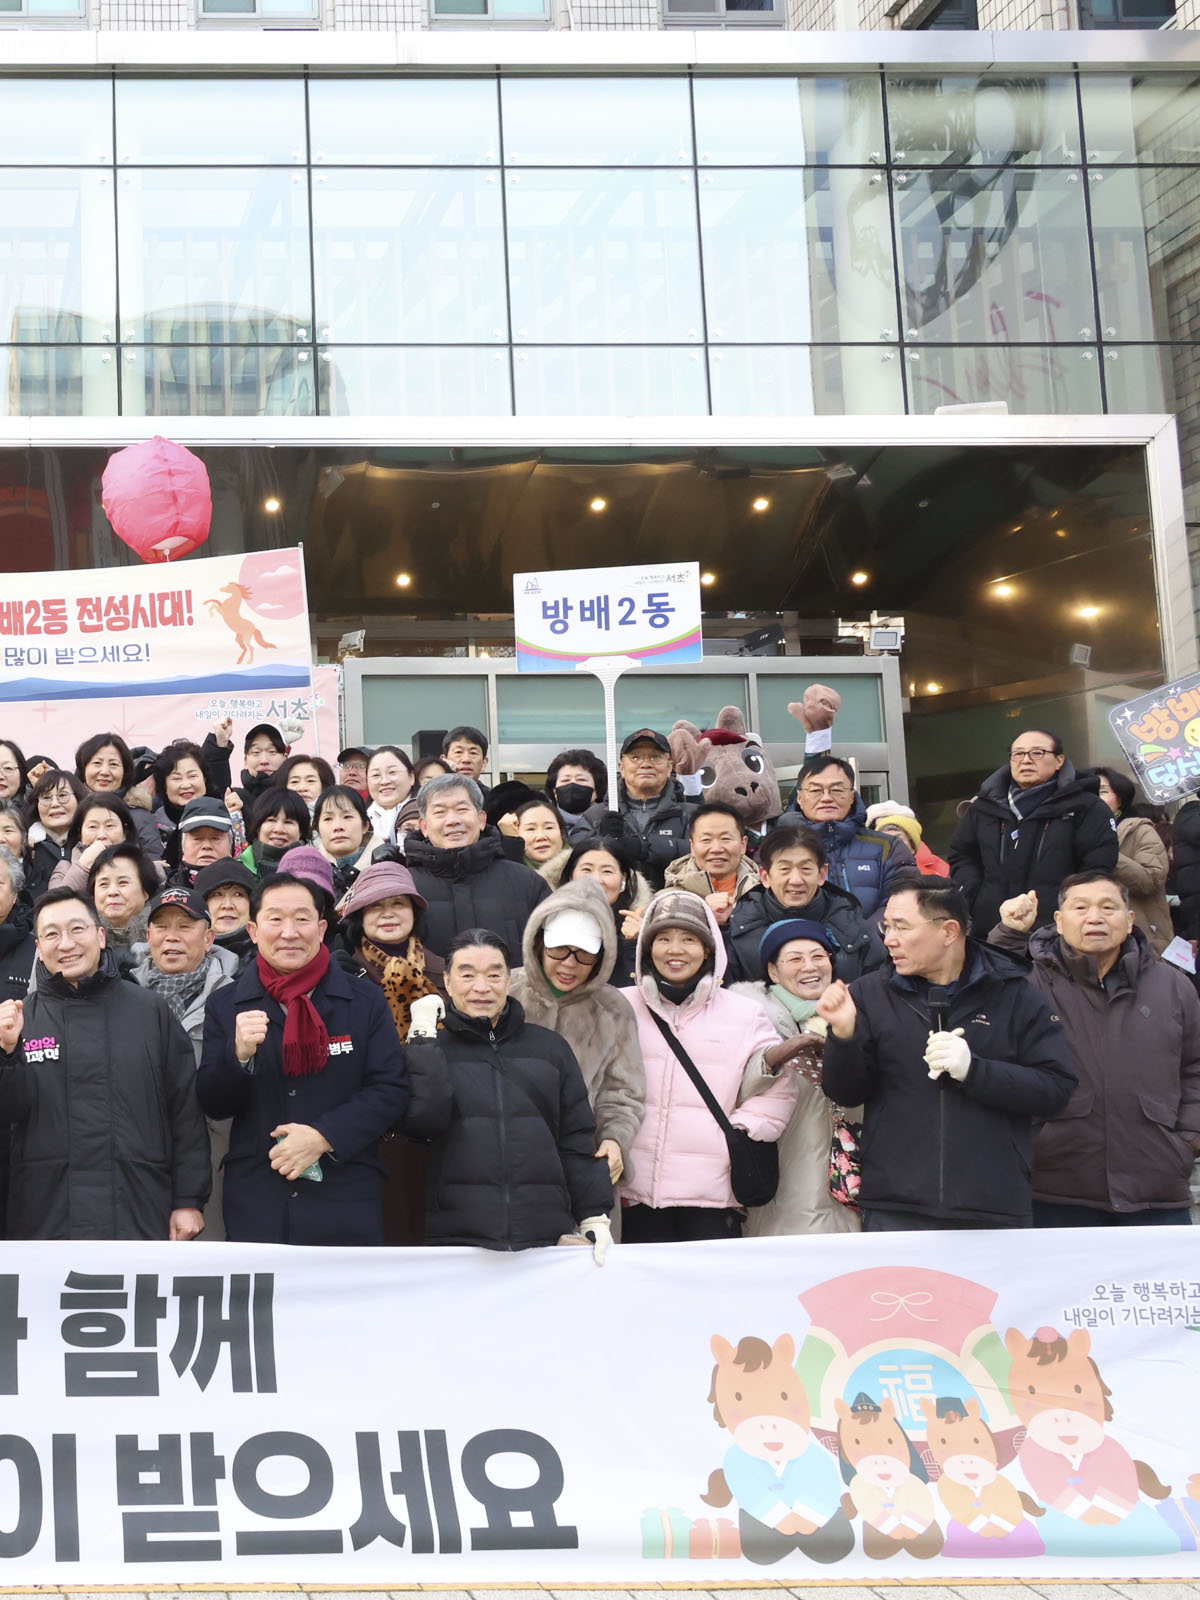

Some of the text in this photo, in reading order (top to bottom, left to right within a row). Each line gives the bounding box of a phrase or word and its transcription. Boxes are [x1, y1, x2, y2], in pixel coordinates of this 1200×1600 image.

[76, 589, 194, 634] 전성시대!
[542, 592, 676, 635] 방배2동
[4, 647, 48, 667] 많이
[55, 642, 150, 665] 받으세요!
[195, 710, 220, 720] 내일이
[210, 699, 264, 709] 오늘 행복하고
[266, 698, 310, 720] 서초
[327, 1041, 354, 1056] 병두
[1092, 1282, 1200, 1303] 오늘 행복하고
[1063, 1306, 1115, 1328] 내일이
[59, 1270, 278, 1397] 함께
[115, 1428, 579, 1563] 받으세요
